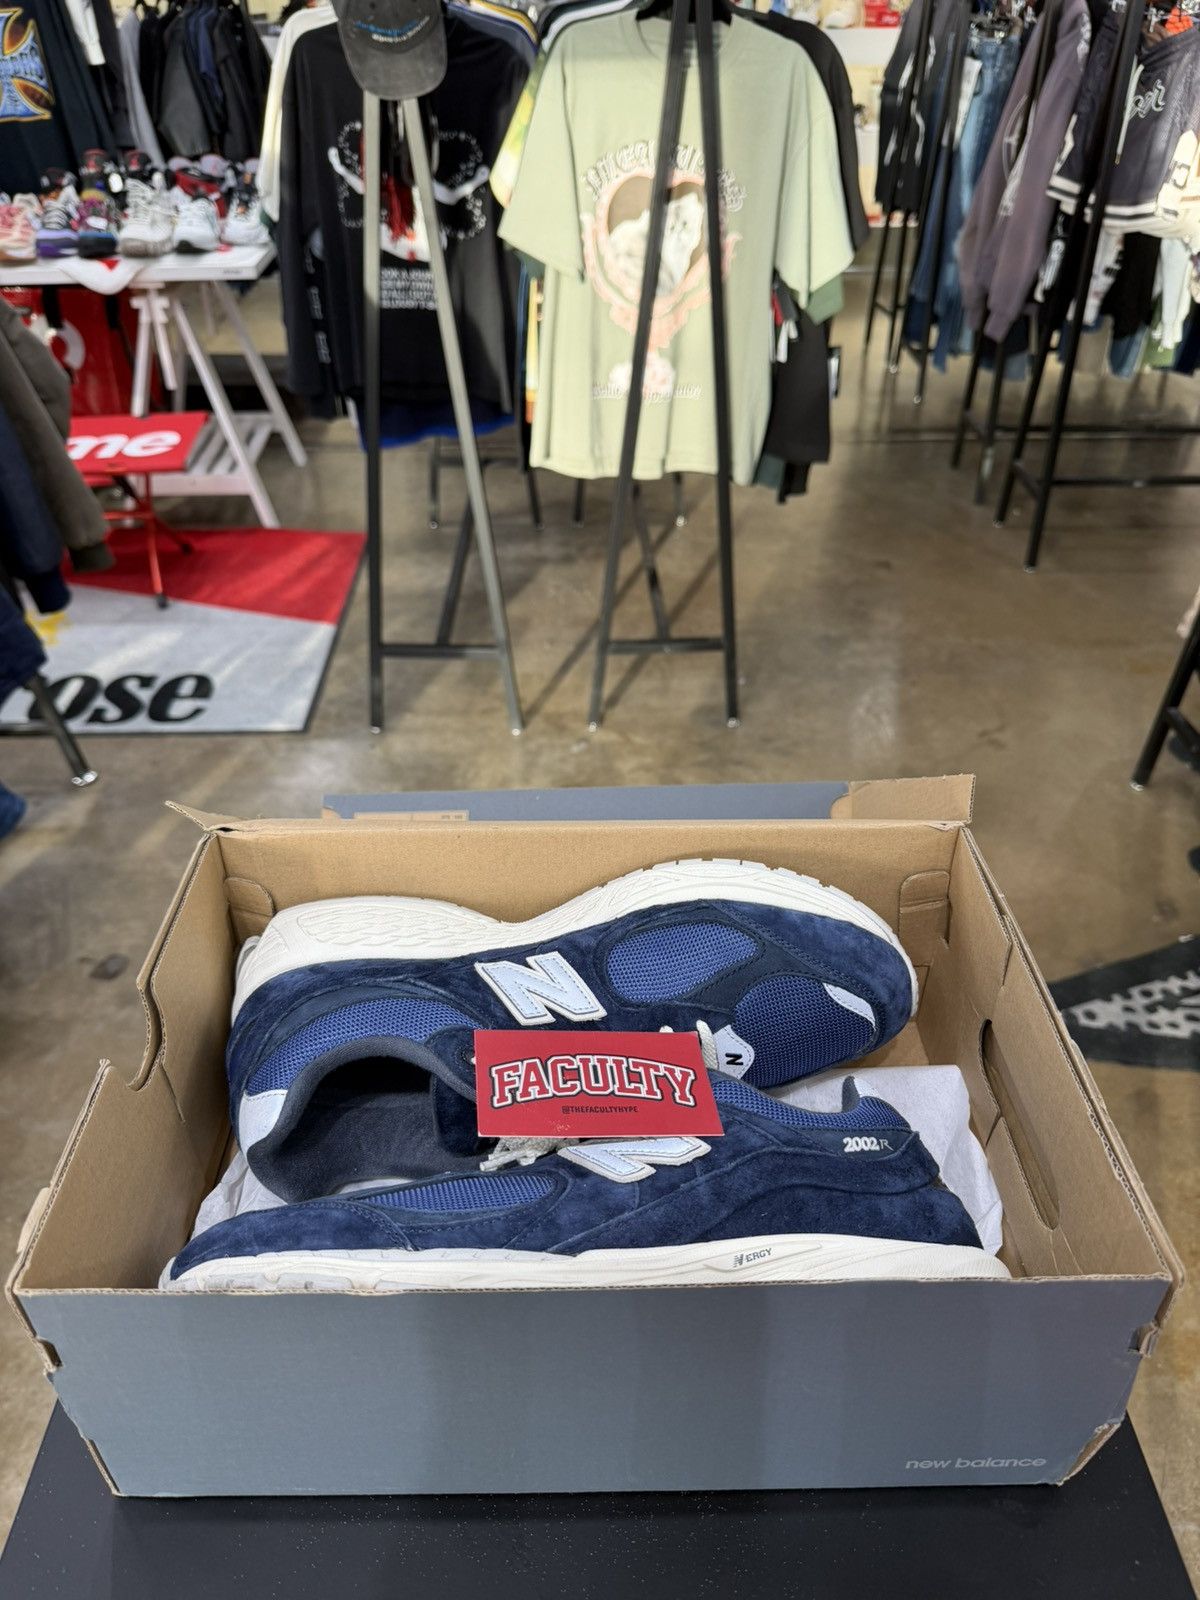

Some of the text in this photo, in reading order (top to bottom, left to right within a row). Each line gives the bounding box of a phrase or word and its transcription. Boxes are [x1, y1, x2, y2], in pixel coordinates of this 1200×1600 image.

[474, 951, 608, 1026] N
[490, 1055, 697, 1109] FACULTY
[561, 1105, 638, 1115] @THEFACULTYHYPE
[905, 1457, 1047, 1469] new balance
